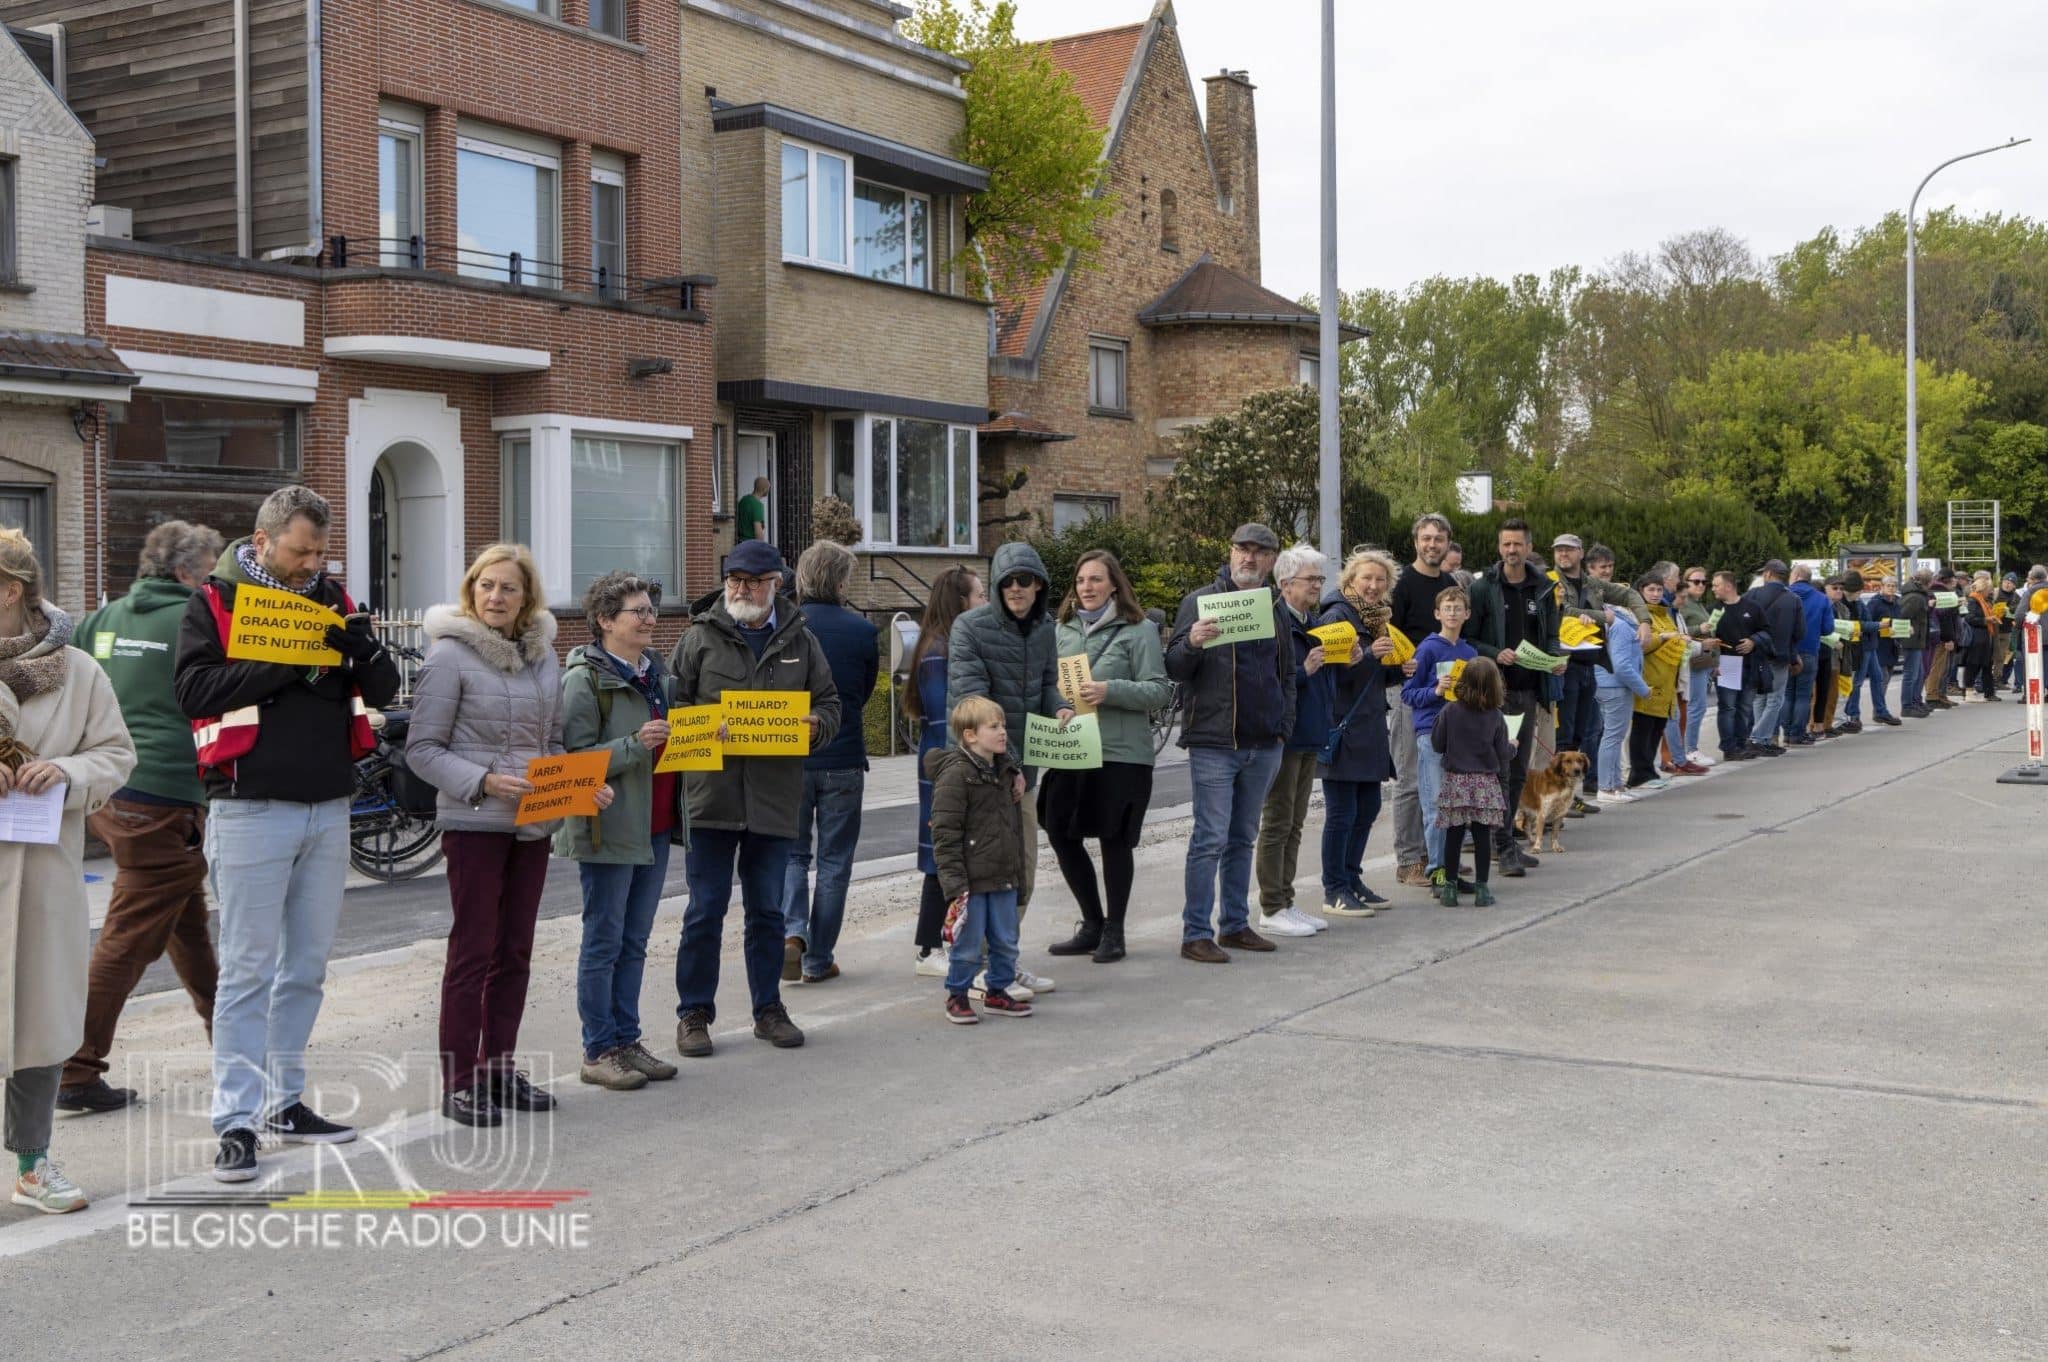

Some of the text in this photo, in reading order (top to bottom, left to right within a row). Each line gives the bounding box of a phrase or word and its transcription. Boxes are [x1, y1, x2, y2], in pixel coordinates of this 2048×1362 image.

[244, 597, 320, 616] 1 MILJARD?
[1203, 598, 1255, 610] NATUUR OP
[240, 615, 290, 628] GRAAG
[1218, 612, 1253, 622] SCHOP,
[1237, 624, 1260, 633] GEK?
[238, 634, 329, 651] IETS NUTTIGS
[1061, 662, 1074, 697] GROENE
[728, 701, 788, 709] 1 MILJARD?
[676, 715, 710, 728] MILJARD?
[727, 717, 799, 727] GRAAG VOOR
[1030, 722, 1082, 734] NATUUR OP
[670, 733, 695, 746] GRAAG
[752, 733, 799, 743] NUTTIGS
[1029, 736, 1081, 748] DE SCHOP,
[1029, 750, 1088, 761] BEN JE GEK?
[532, 764, 563, 778] JAREN
[573, 777, 597, 788] NEE,
[524, 796, 573, 812] BEDANKT!
